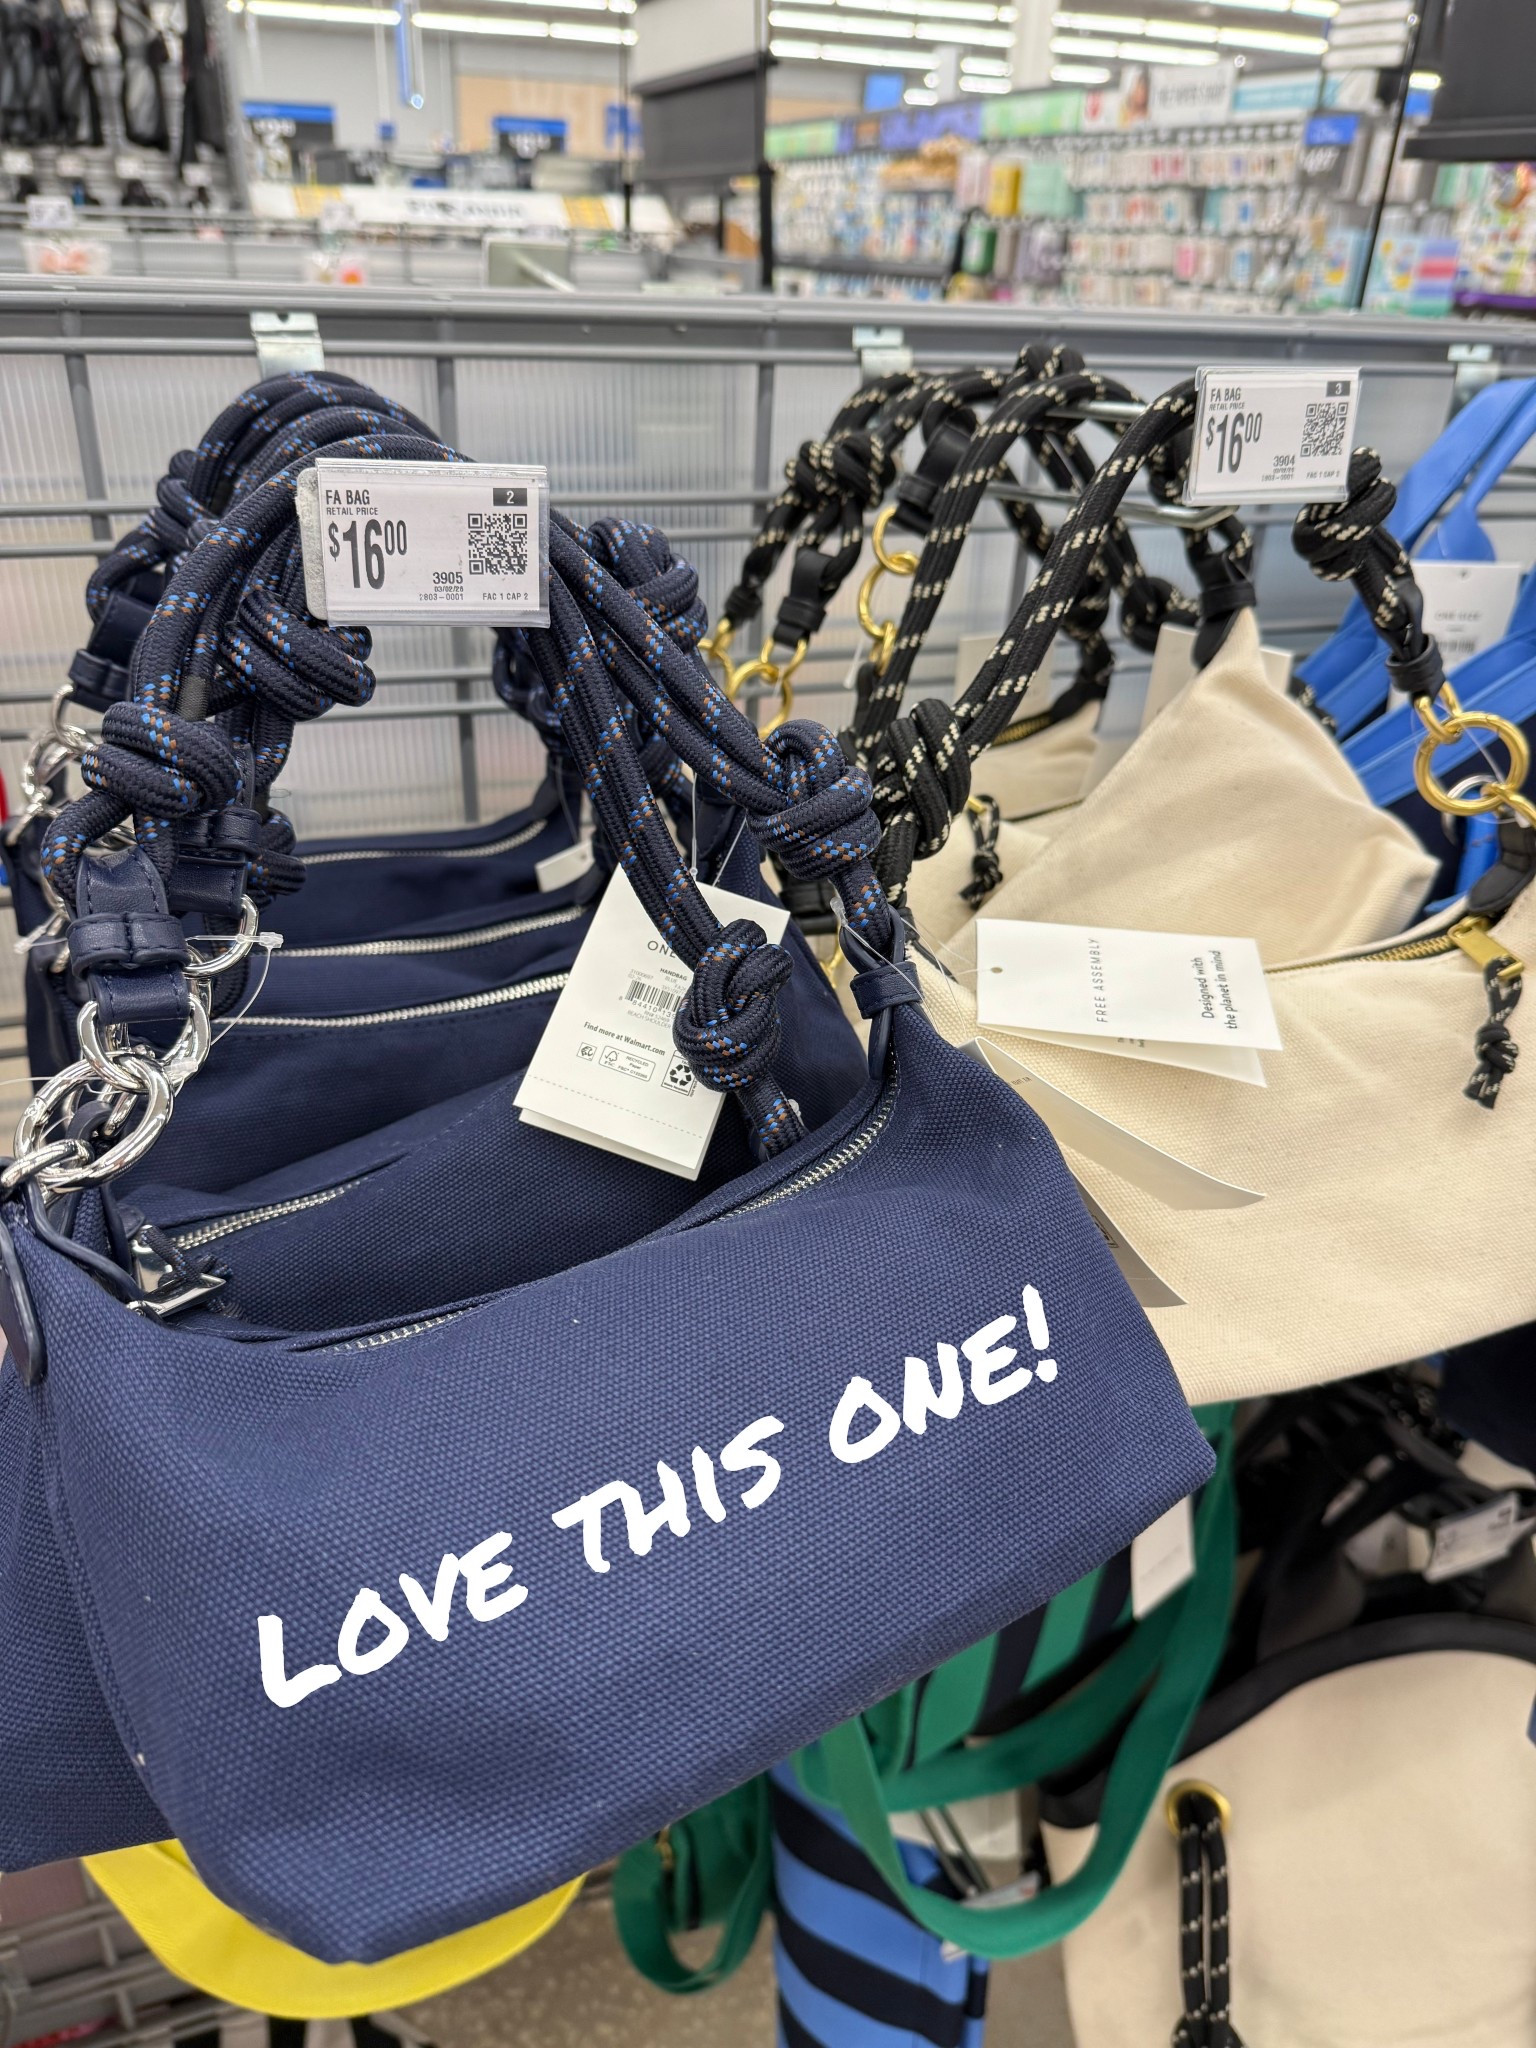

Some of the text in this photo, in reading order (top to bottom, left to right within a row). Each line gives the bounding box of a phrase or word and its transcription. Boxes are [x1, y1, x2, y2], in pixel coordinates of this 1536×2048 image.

[1210, 387, 1242, 403] FA BAG
[1335, 383, 1342, 395] 3
[1273, 455, 1296, 467] 3904
[325, 489, 370, 506] FA BAG
[506, 491, 515, 504] 2
[326, 507, 379, 516] RETAIL PRICE
[432, 571, 464, 585] 3905
[482, 592, 529, 601] FAC 1 CAP 2
[659, 967, 688, 981] HANDBAG
[1087, 937, 1108, 1023] FREE ASSEMBLY
[1190, 957, 1215, 1019] Designed with
[1208, 950, 1239, 1029] the planet in mind
[632, 999, 658, 1012] 84410
[644, 1015, 672, 1029] SHOULDER
[583, 1020, 666, 1056] Find more at Walmart.com
